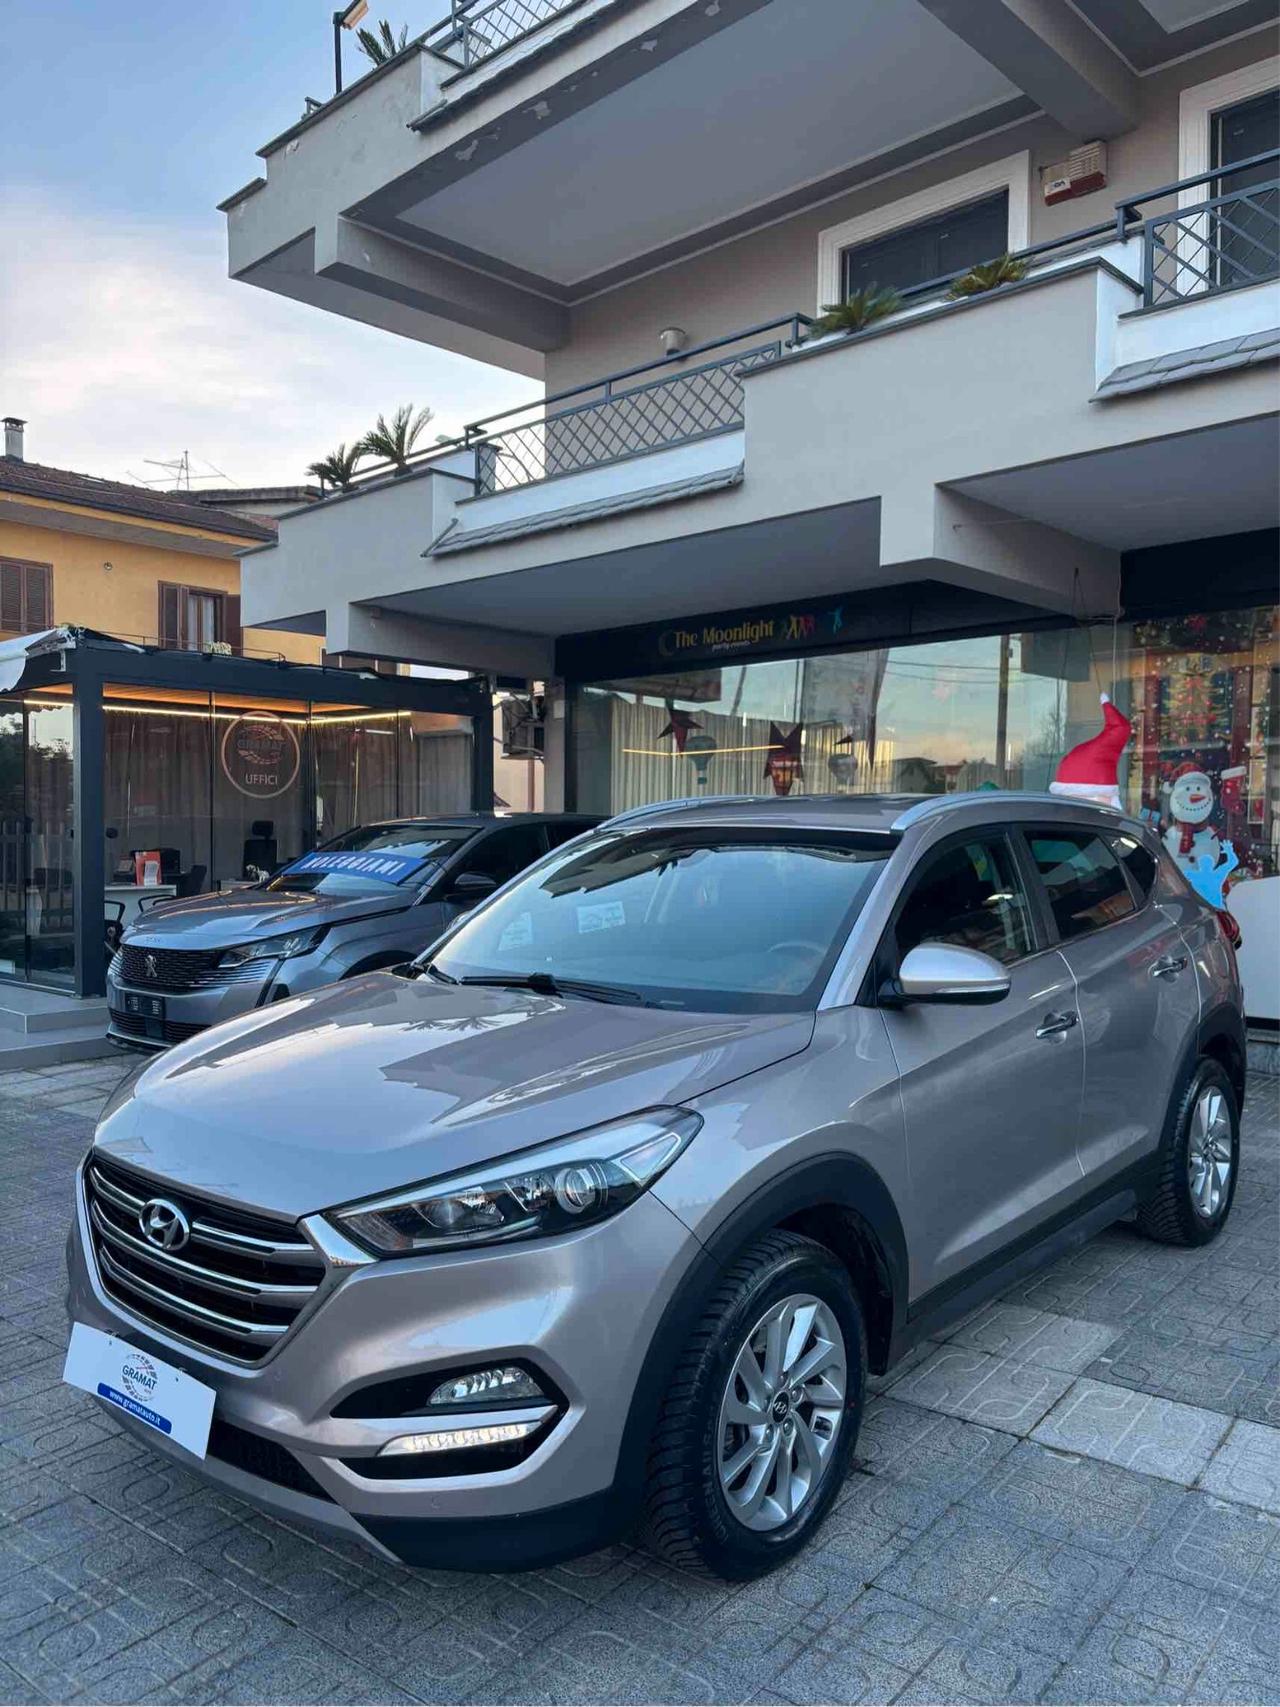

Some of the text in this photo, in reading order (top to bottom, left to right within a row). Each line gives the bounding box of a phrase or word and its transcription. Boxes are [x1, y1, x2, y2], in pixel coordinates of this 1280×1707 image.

[674, 619, 775, 649] The Moonlight
[245, 773, 278, 785] UFFICI
[301, 856, 406, 876] NOLEGGIAMI
[122, 1364, 157, 1390] GRAMAT
[109, 1390, 161, 1426] www.gramatauto.it
